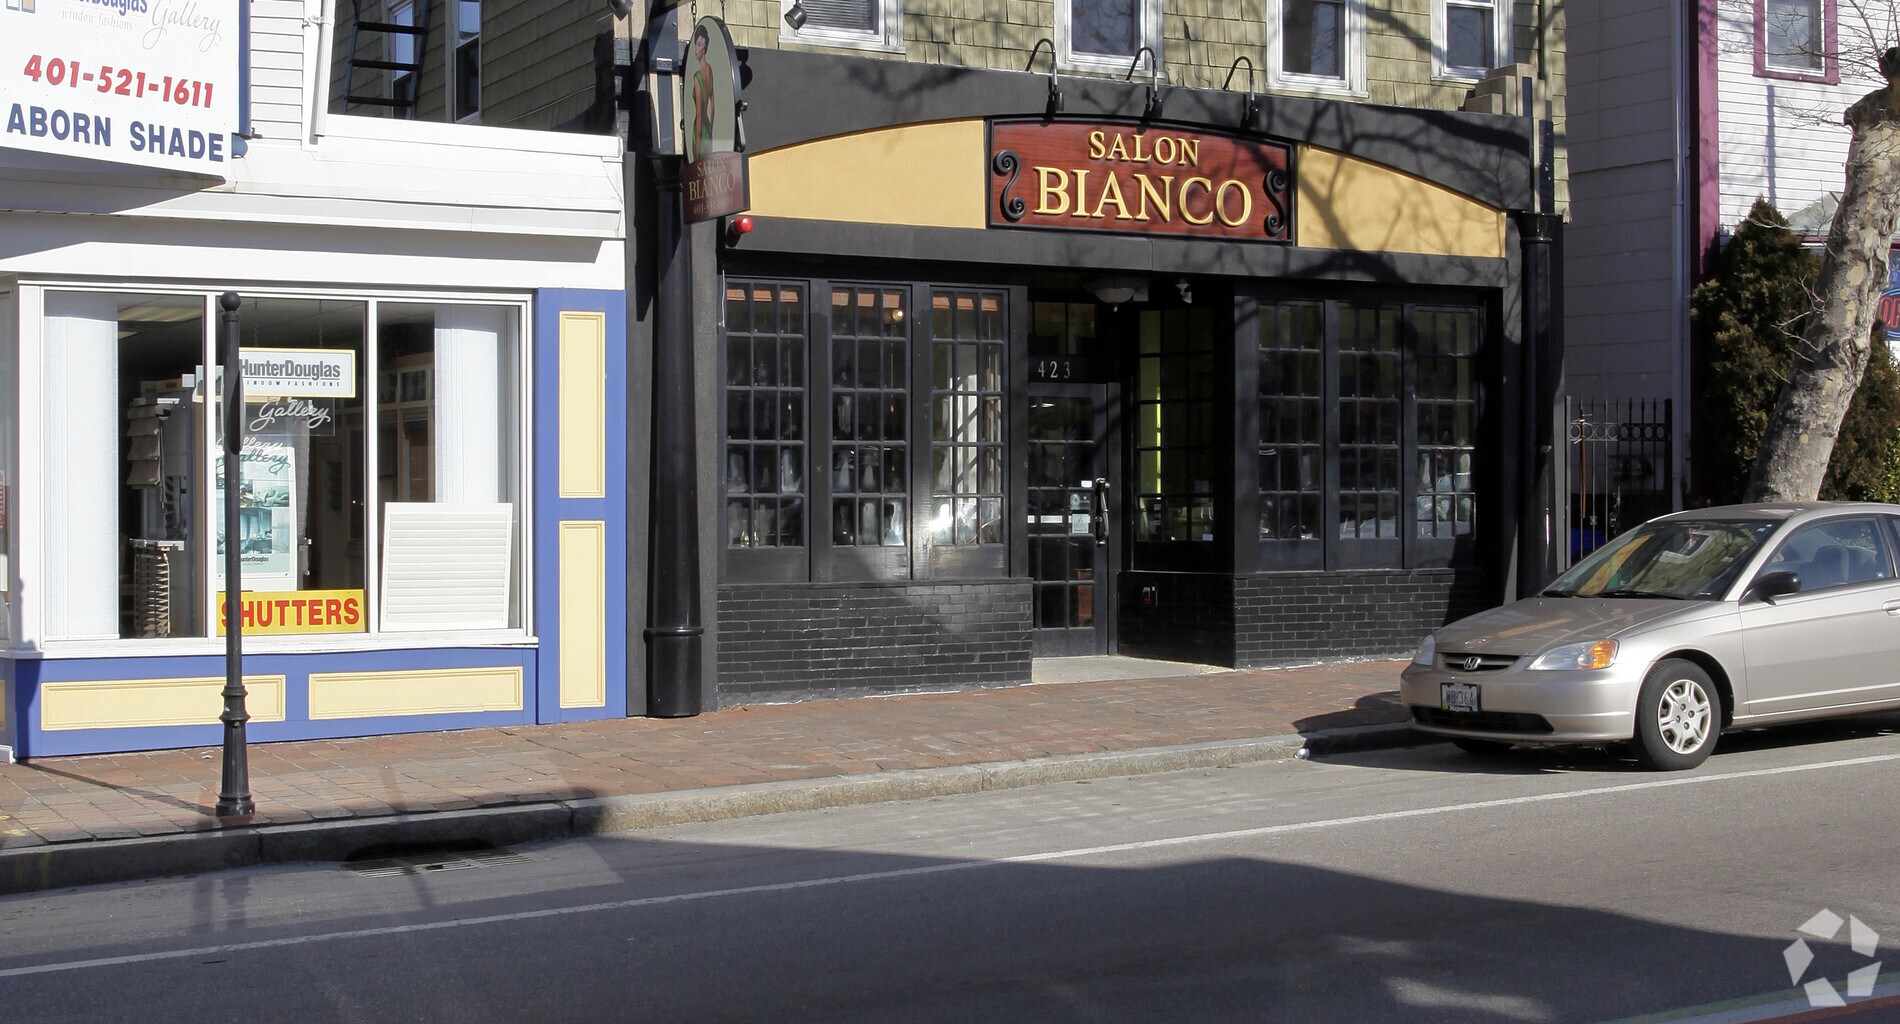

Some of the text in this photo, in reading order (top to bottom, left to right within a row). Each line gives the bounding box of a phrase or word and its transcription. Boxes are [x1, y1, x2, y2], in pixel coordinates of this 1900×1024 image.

[62, 7, 133, 31] window fashions
[24, 54, 214, 108] 401-521-1611
[7, 102, 224, 163] ABORN SHADE
[1088, 130, 1200, 166] SALON
[697, 157, 725, 176] SALON
[689, 170, 736, 202] BIANCO
[1032, 165, 1252, 228] BIANCO
[1038, 361, 1071, 379] 423
[249, 396, 331, 432] Gallery
